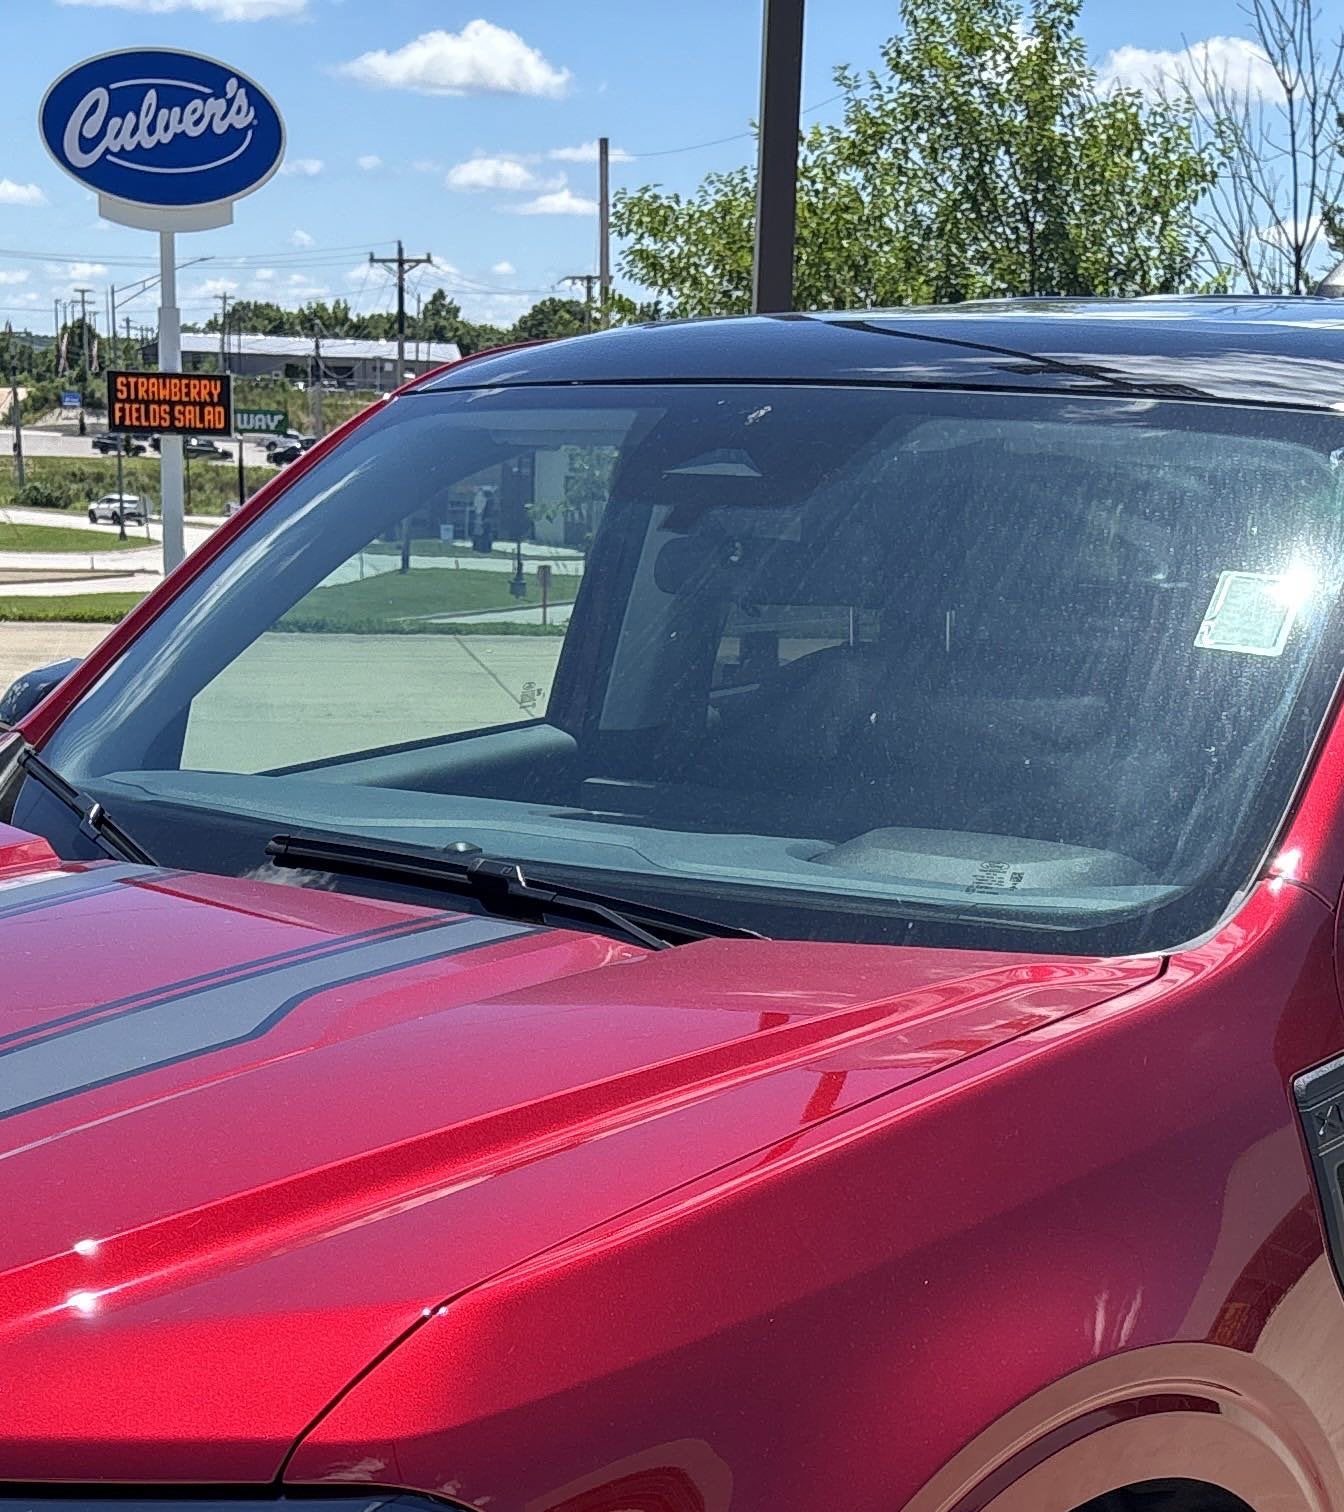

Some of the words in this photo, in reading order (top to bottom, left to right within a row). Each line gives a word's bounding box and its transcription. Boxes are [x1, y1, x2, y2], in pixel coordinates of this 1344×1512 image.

[64, 77, 255, 169] Culver's
[116, 376, 222, 403] STRAWBERRY
[114, 402, 171, 428] FIELDS
[174, 405, 226, 430] SALAD
